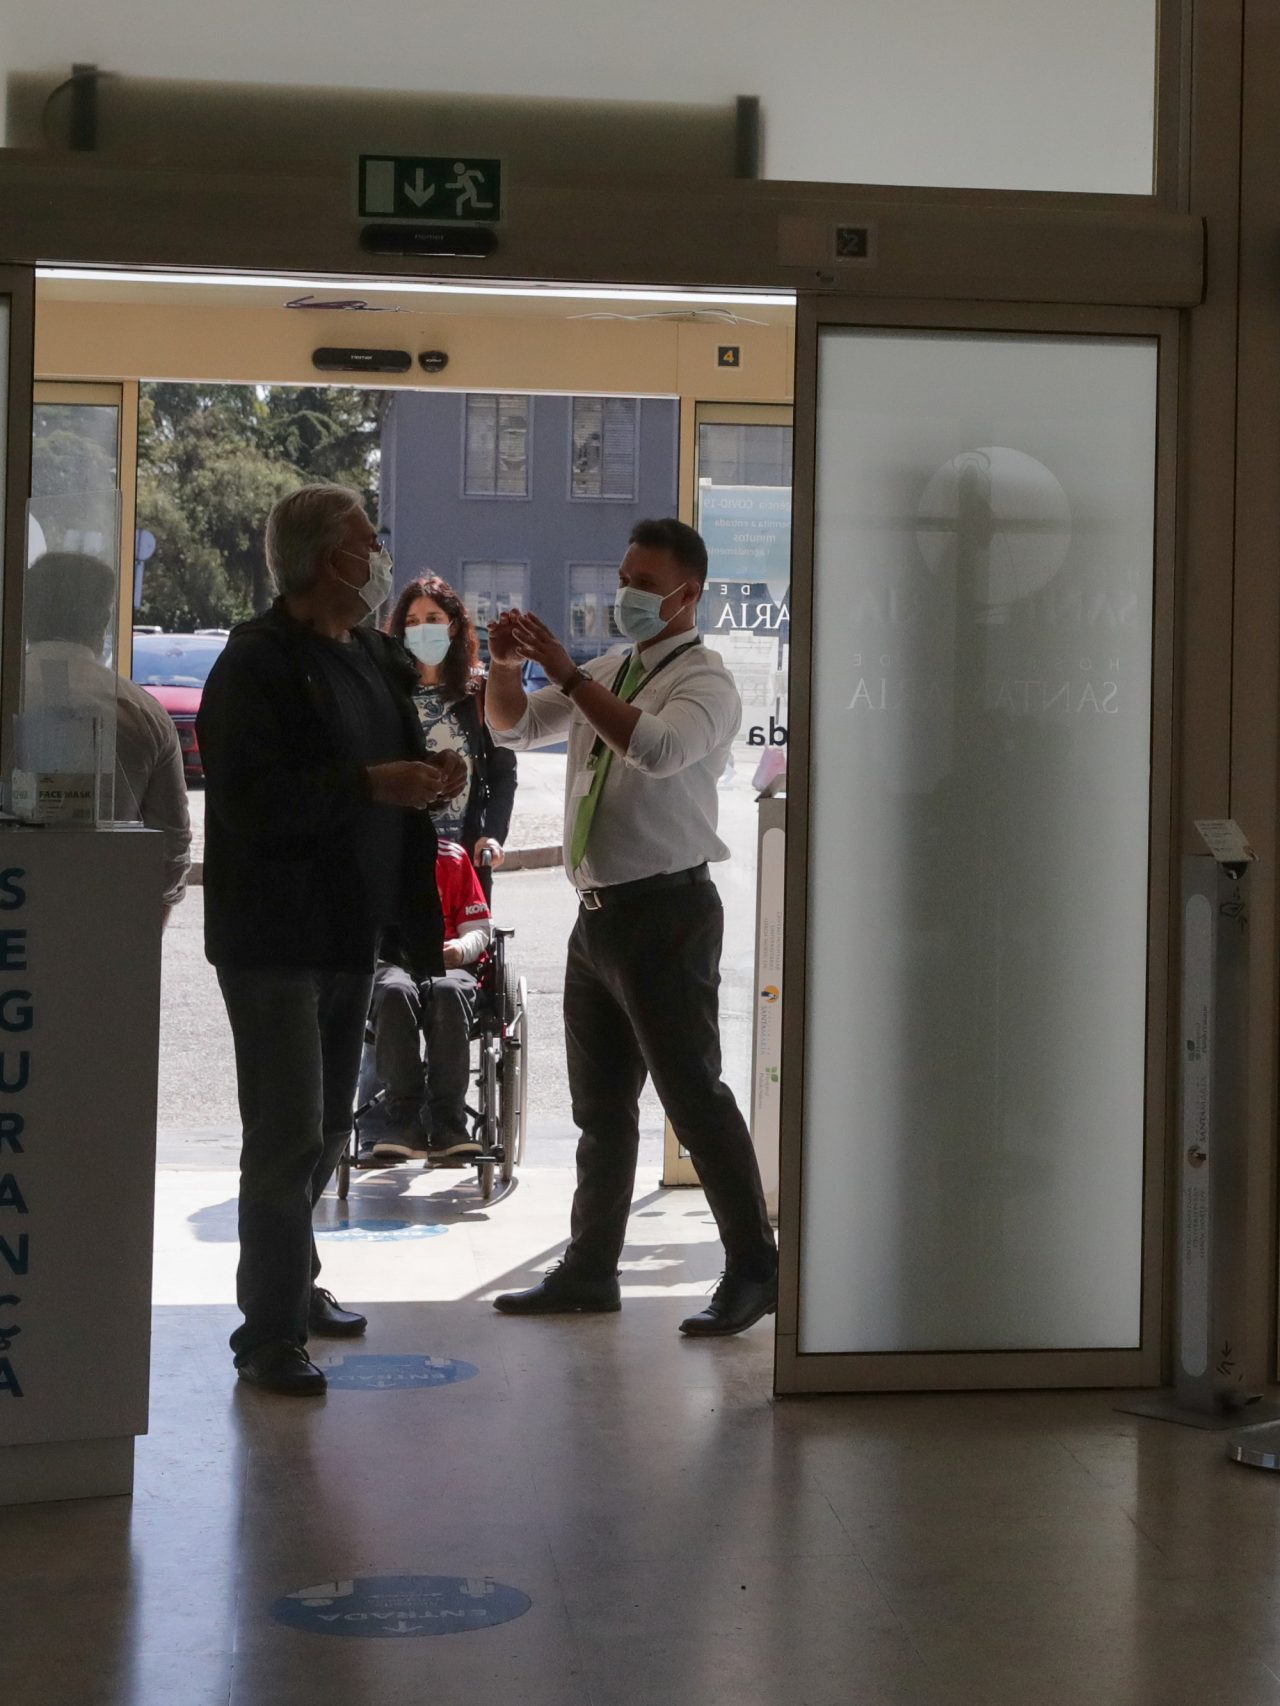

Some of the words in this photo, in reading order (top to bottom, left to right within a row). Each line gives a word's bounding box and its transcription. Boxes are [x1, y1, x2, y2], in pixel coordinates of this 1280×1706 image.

[723, 350, 735, 363] 4
[39, 790, 63, 799] FACE
[64, 791, 92, 799] MASK
[317, 1609, 487, 1622] ENTRADA
